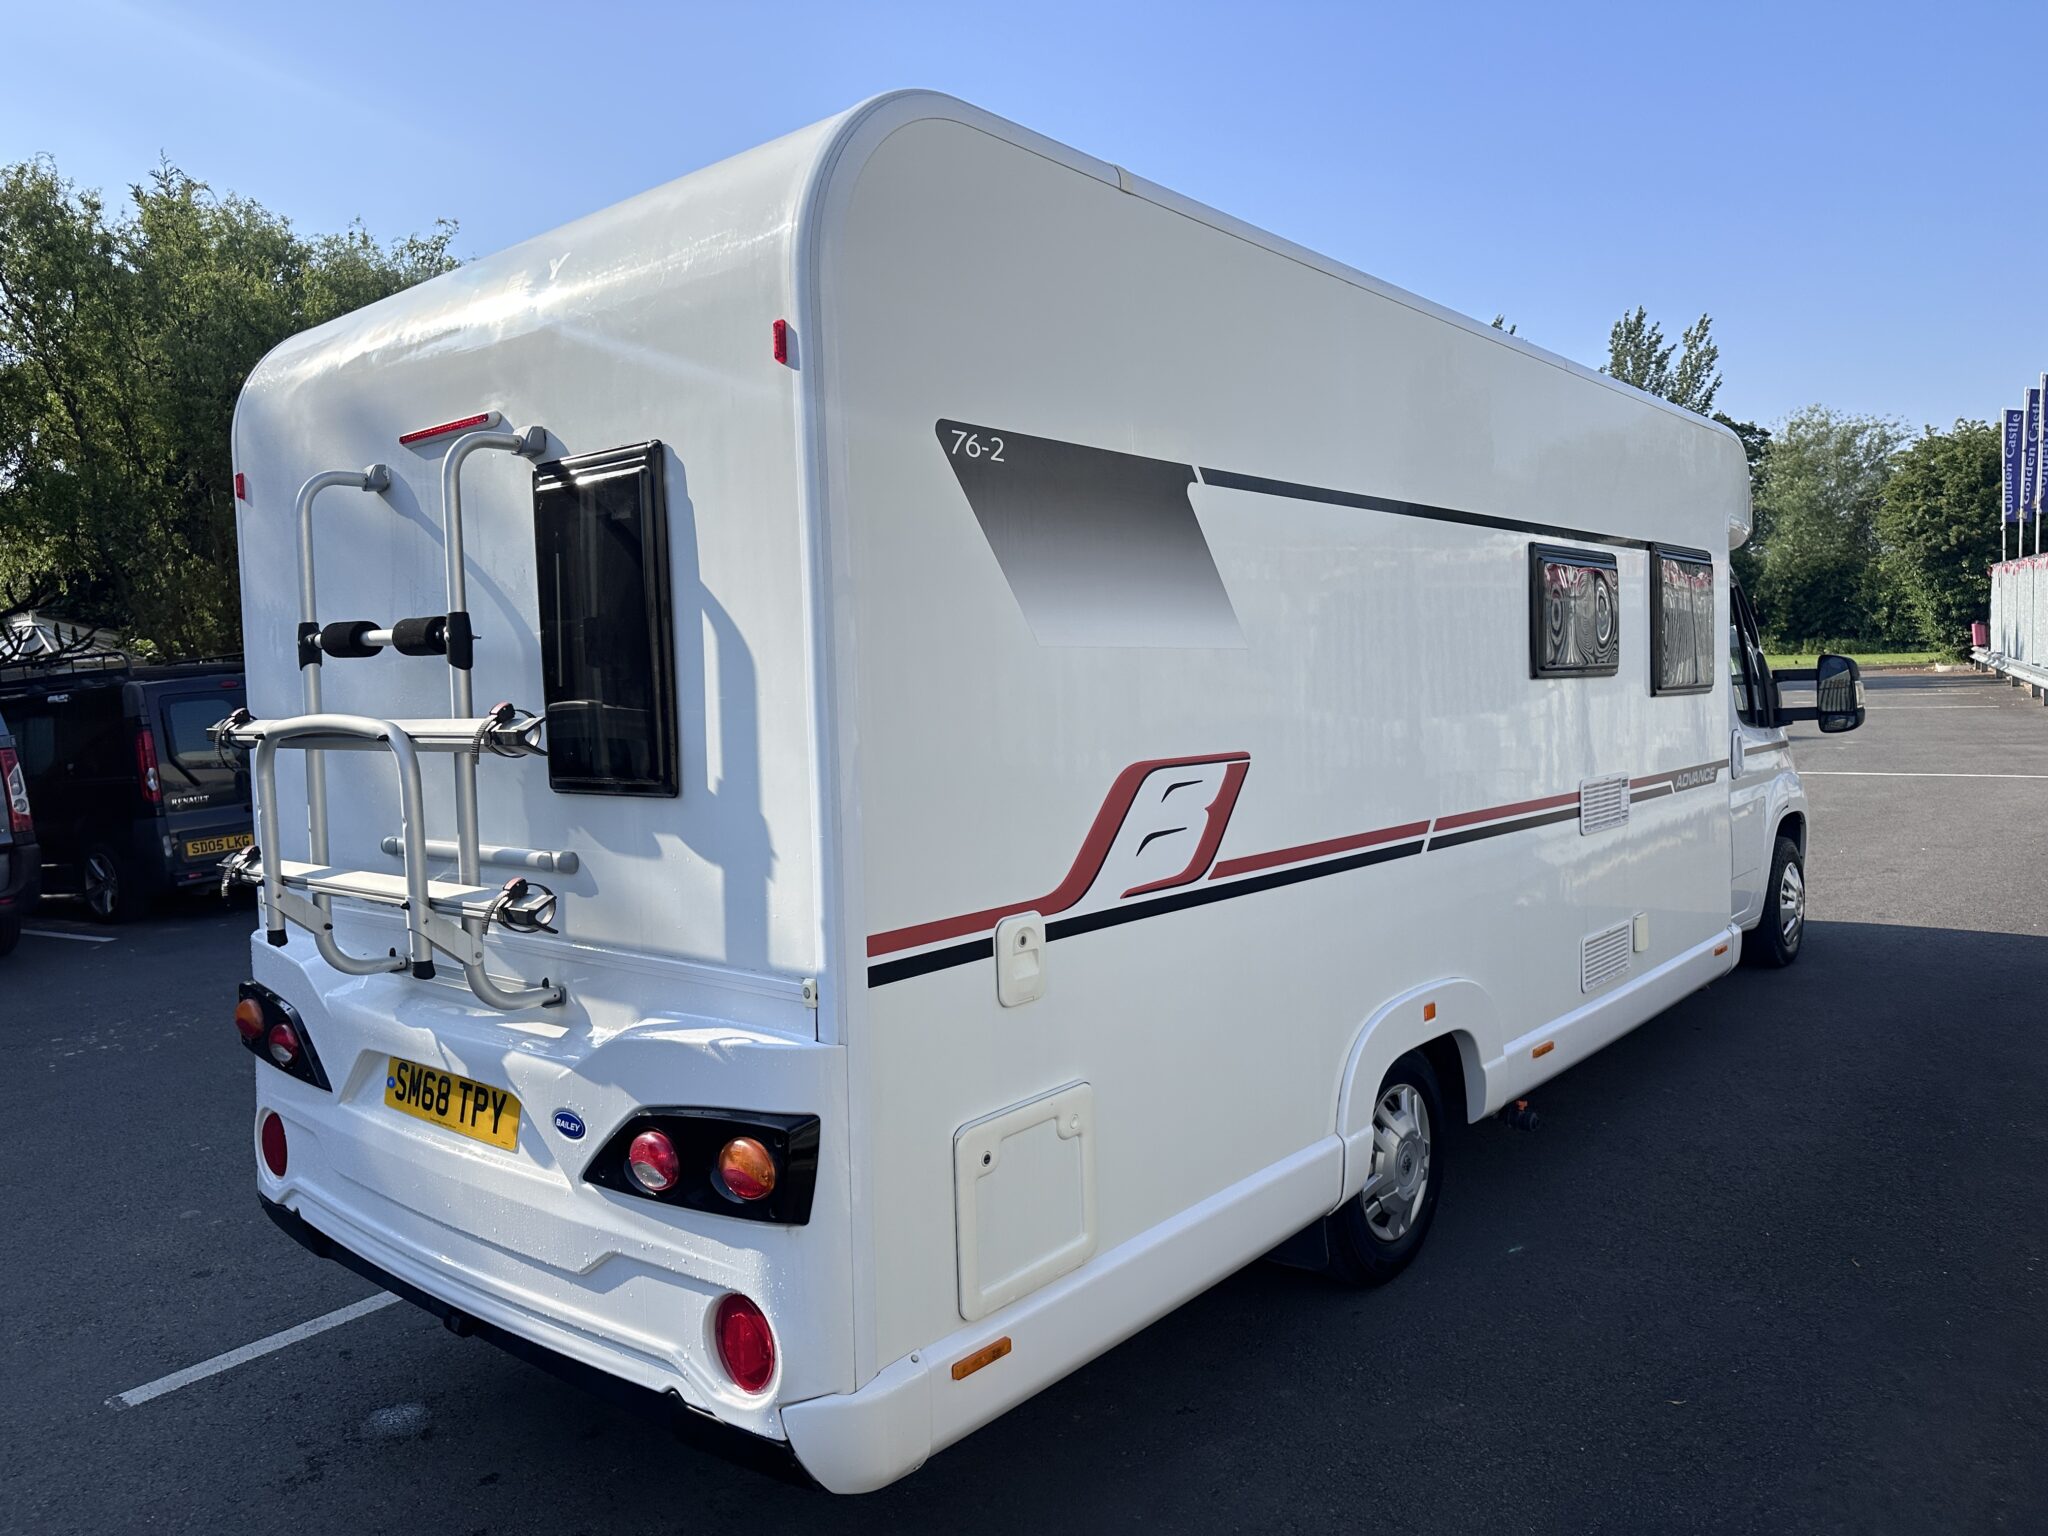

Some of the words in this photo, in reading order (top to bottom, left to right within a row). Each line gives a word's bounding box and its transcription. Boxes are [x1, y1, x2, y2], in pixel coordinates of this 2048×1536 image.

[951, 429, 1005, 463] 76-2
[2005, 413, 2022, 459] Castle
[1676, 766, 1716, 790] ADVANCE
[171, 795, 210, 806] RENAULT
[191, 839, 224, 855] SD05
[226, 835, 250, 851] LKG
[394, 1061, 452, 1117] SM68
[458, 1080, 508, 1135] TPY
[555, 1118, 581, 1132] BAILEY
